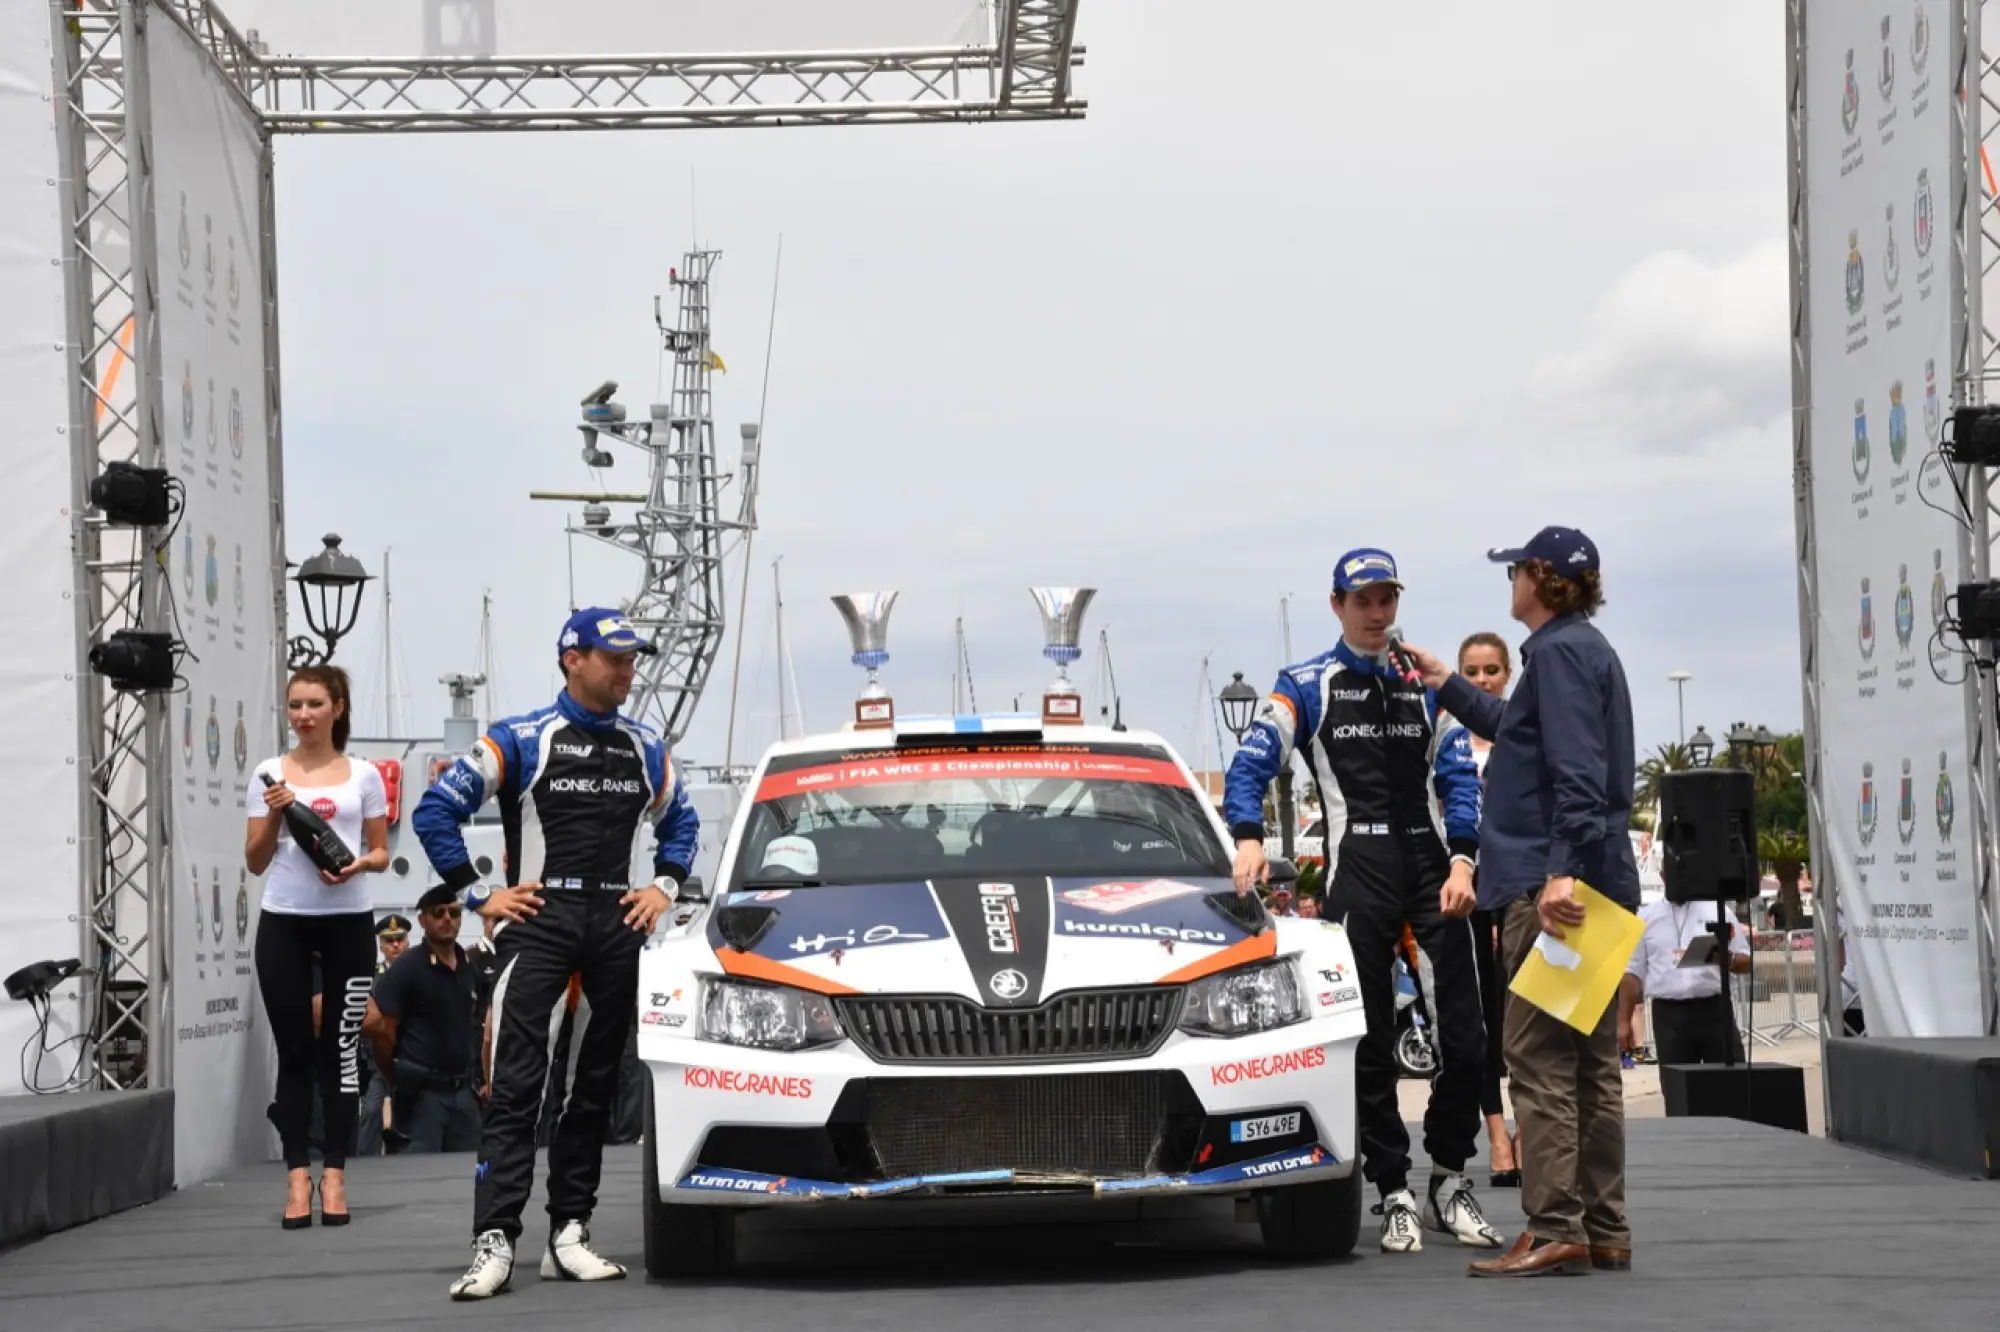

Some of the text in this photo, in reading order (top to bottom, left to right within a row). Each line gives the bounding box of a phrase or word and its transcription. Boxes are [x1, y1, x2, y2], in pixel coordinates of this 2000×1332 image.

[849, 766, 880, 778] FIA
[883, 761, 925, 776] WRC
[930, 762, 942, 773] 2
[946, 758, 1071, 773] Championship
[1210, 1045, 1327, 1086] KONECRANES
[683, 1066, 814, 1099] KONECRANES
